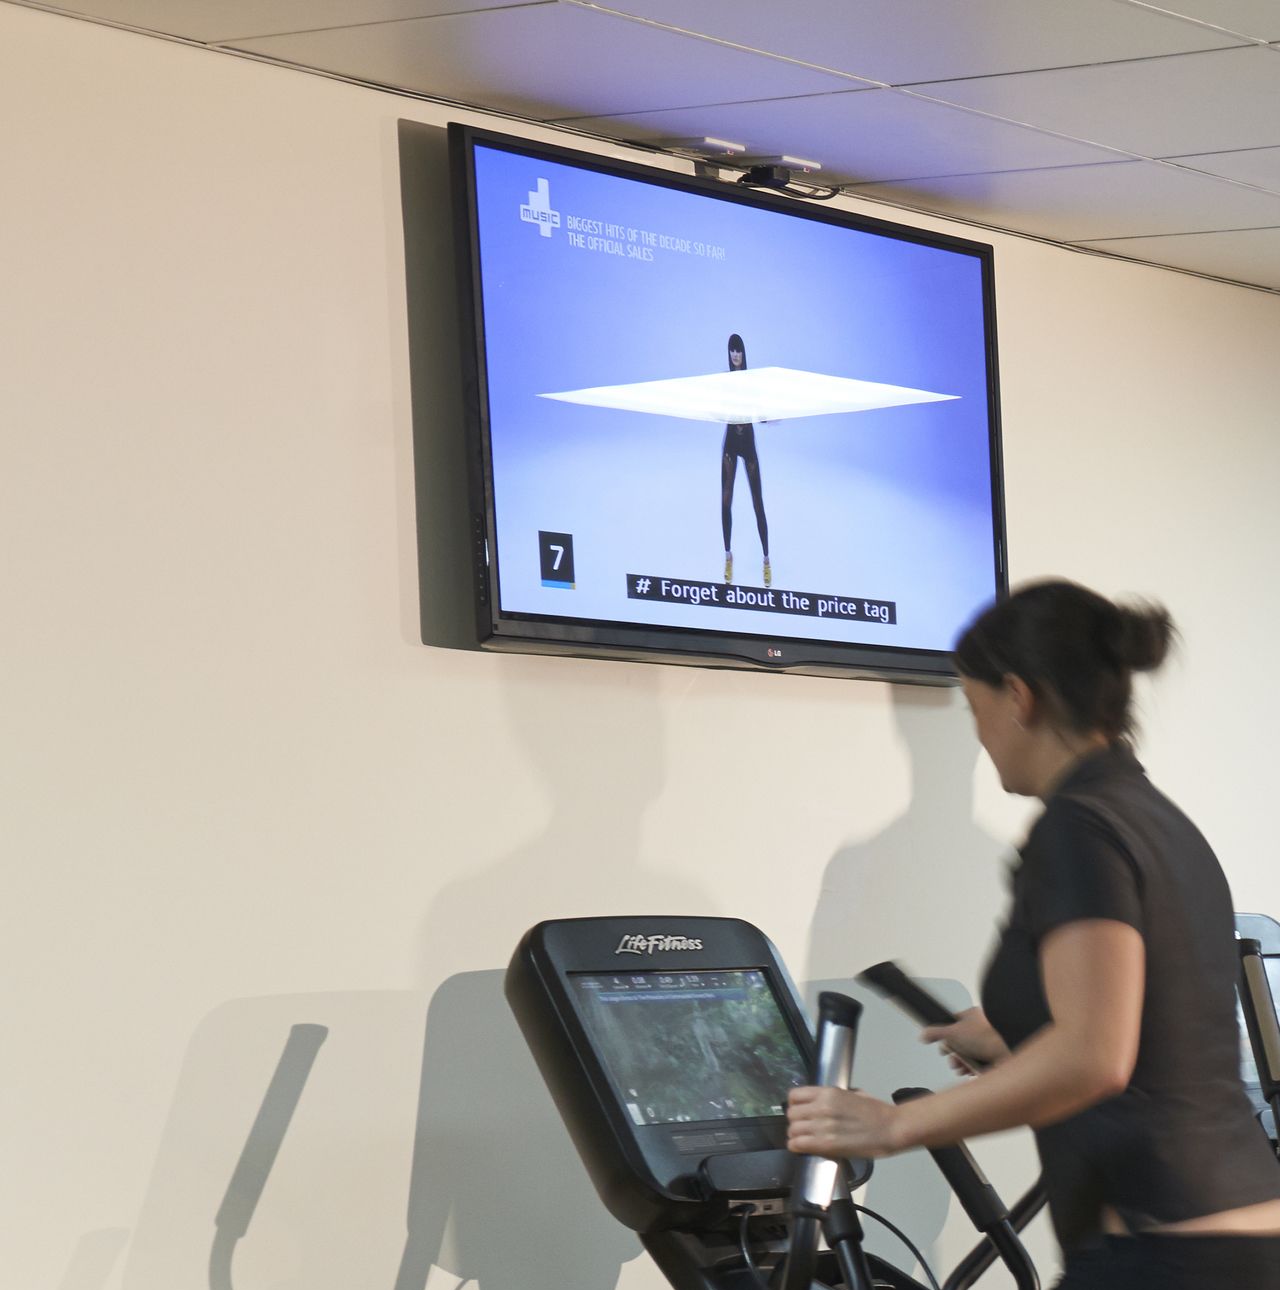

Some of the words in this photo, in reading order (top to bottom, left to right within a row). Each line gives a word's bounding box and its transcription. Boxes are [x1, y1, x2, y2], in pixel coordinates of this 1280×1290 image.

[566, 215, 603, 235] BIGGEST
[605, 223, 625, 240] HITS
[627, 228, 639, 242] OF
[640, 230, 657, 246] THE
[659, 235, 691, 254] DECADE
[693, 242, 704, 257] SO
[706, 245, 726, 261] FAR!
[567, 232, 585, 248] THE
[587, 235, 625, 257] OFFICIAL
[627, 245, 654, 262] SALES
[550, 545, 564, 571] 7
[635, 577, 651, 594] #
[661, 580, 719, 605] Forget
[726, 586, 775, 608] about
[782, 591, 809, 611] the
[817, 596, 857, 617] price
[863, 600, 890, 623] tag
